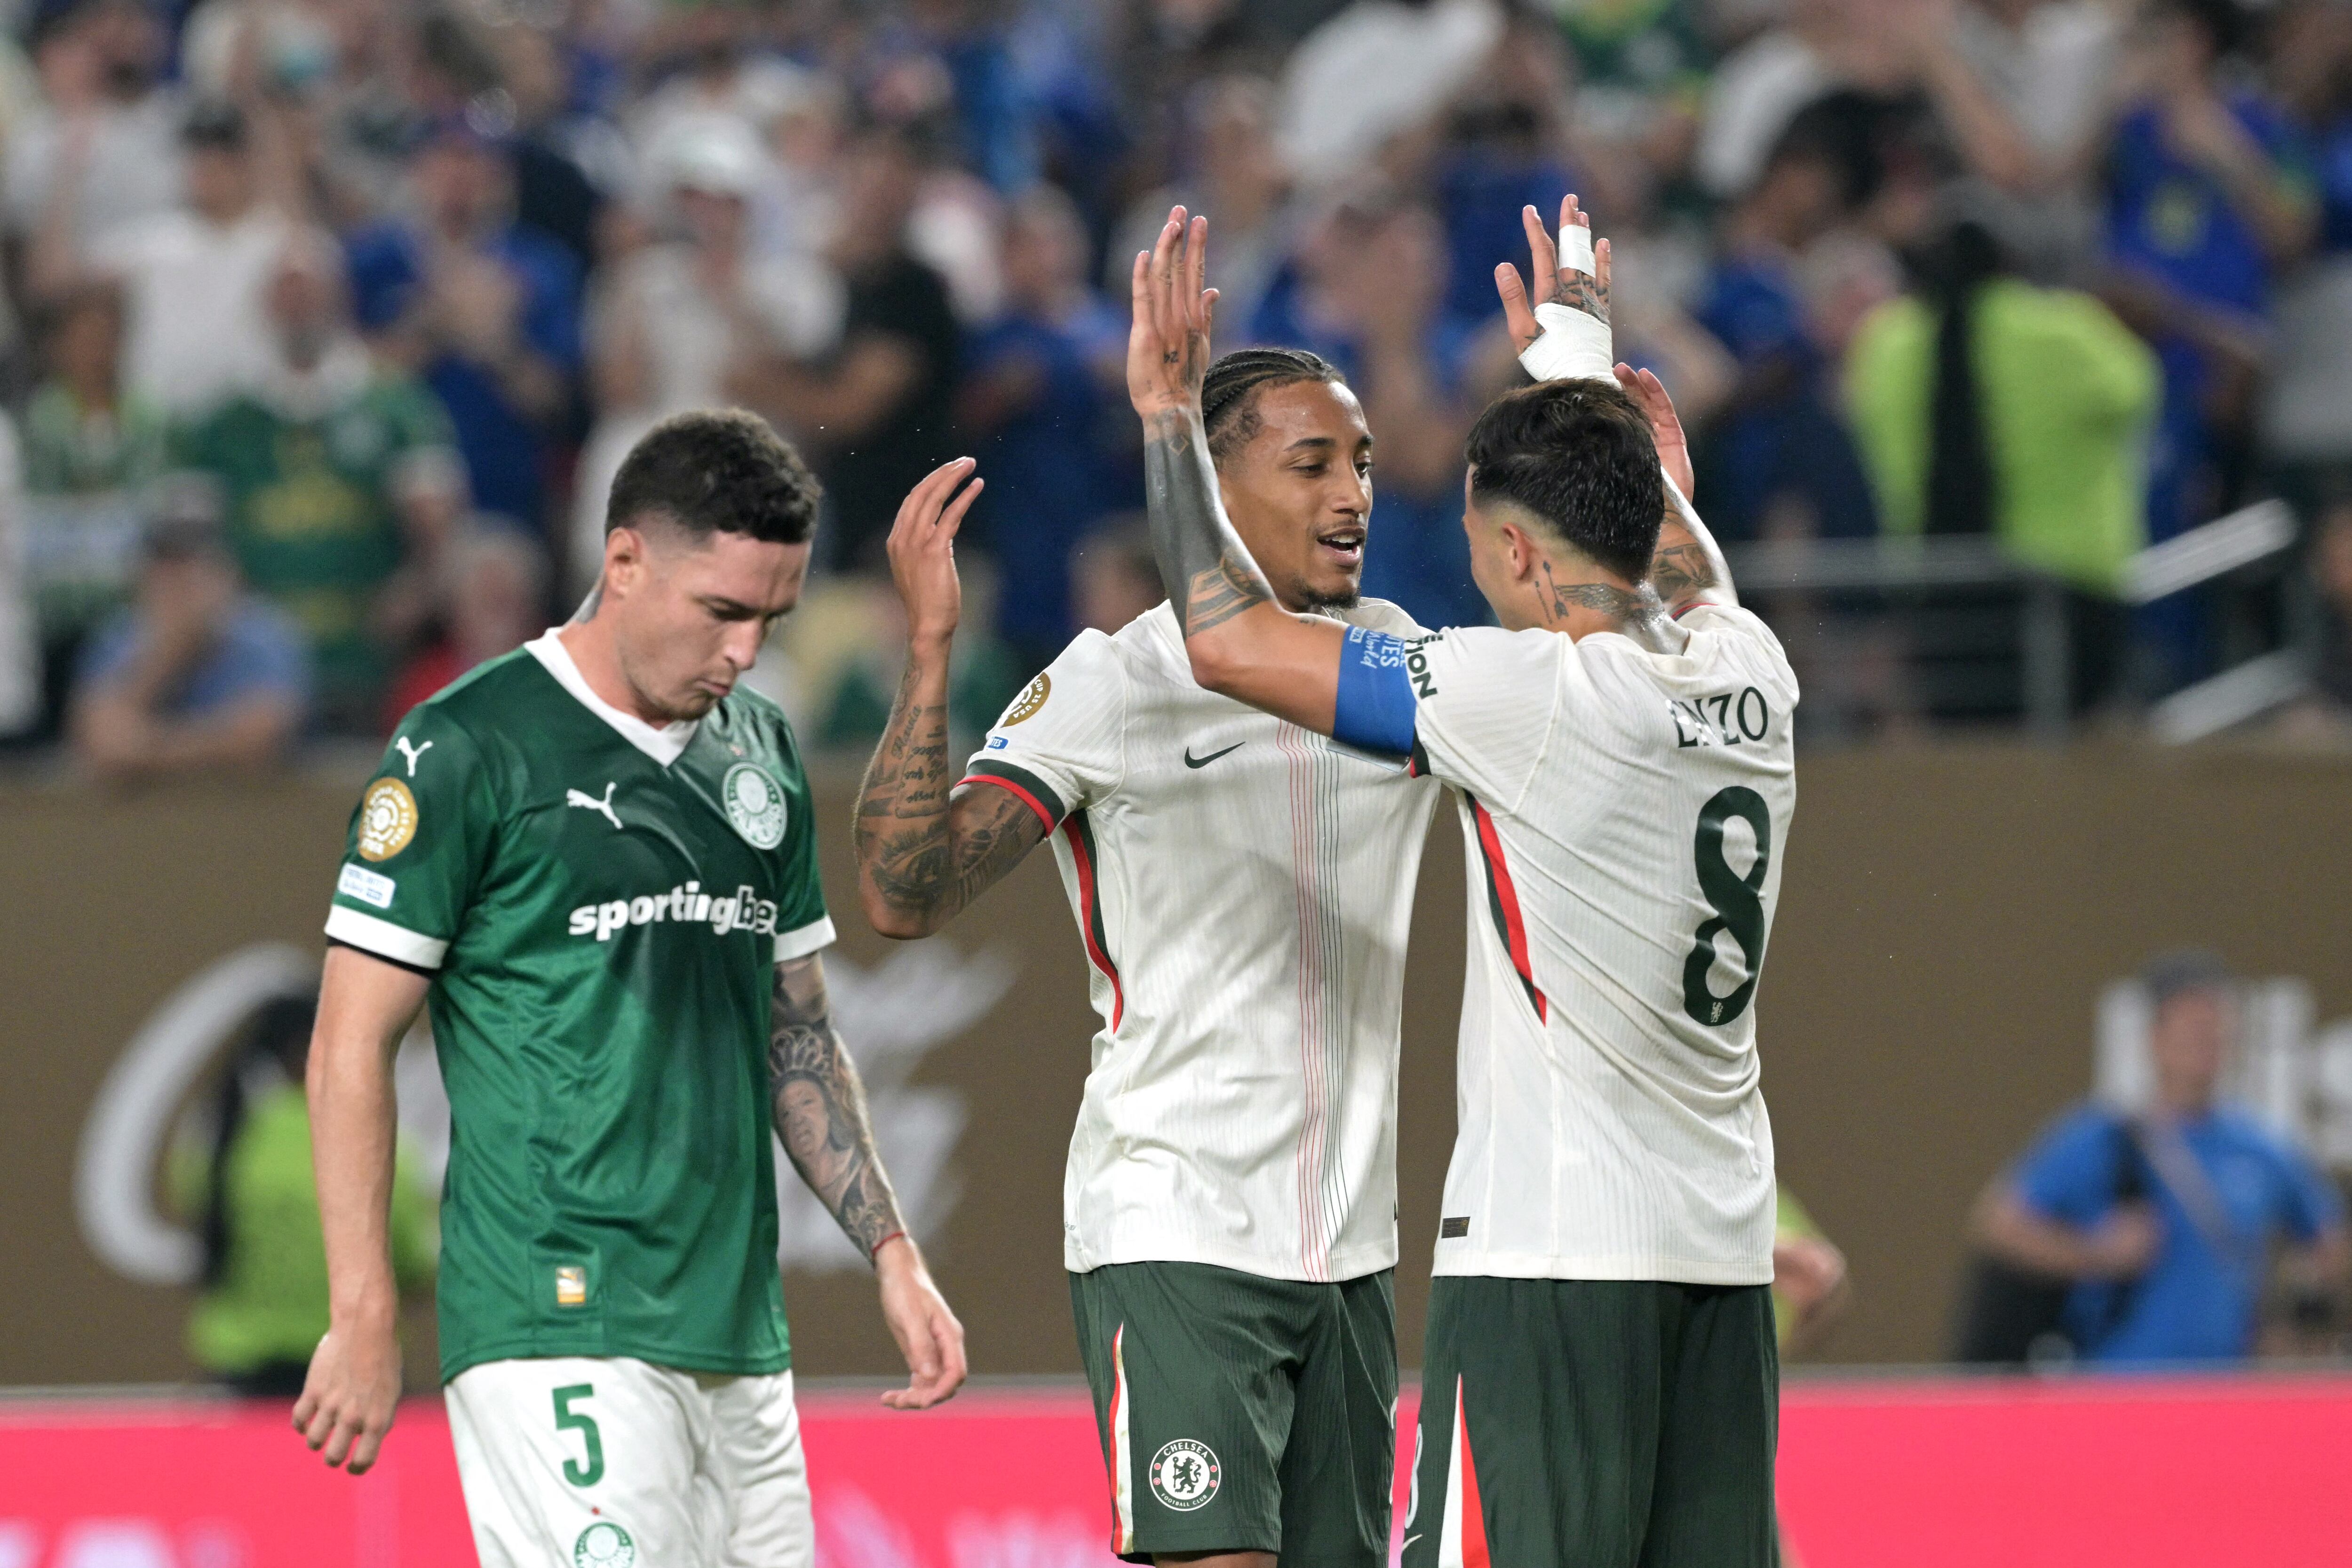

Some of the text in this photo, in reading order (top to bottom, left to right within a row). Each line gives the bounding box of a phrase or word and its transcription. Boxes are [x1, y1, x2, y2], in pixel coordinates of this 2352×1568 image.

[1034, 679, 1043, 692] CUP
[1406, 637, 1438, 700] TION
[1013, 705, 1033, 718] USA
[1666, 686, 1769, 748] ENZO
[568, 880, 777, 941] sportingbe
[1683, 785, 1771, 1027] 8
[552, 1382, 605, 1488] 5
[1163, 1442, 1208, 1458] CHELSEA
[1160, 1493, 1208, 1507] FOOTBALL CLUB
